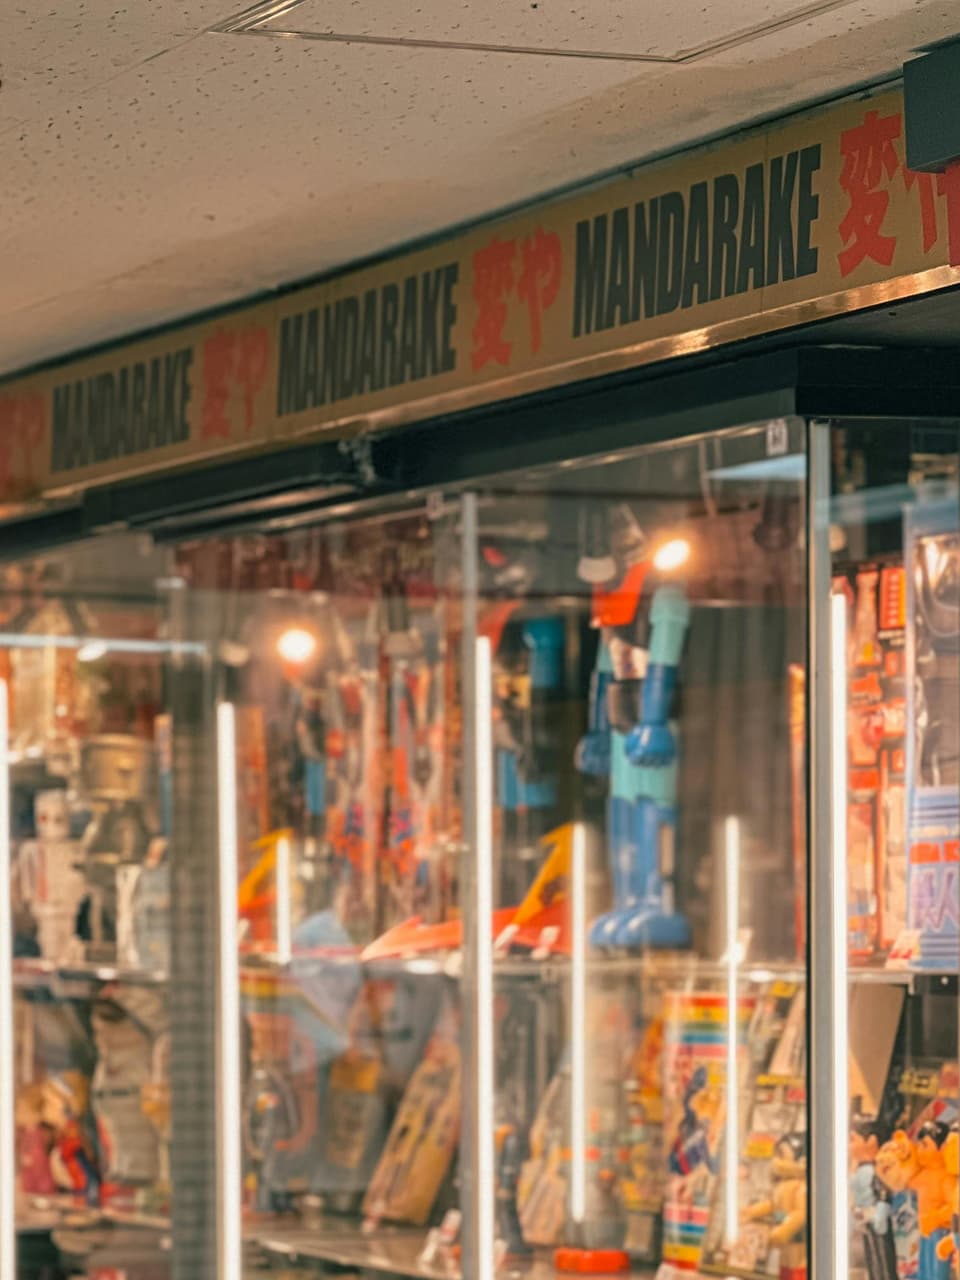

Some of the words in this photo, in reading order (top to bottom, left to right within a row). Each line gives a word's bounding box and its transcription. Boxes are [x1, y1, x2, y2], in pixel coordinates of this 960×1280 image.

[52, 345, 195, 474] MANDARAKE
[201, 325, 269, 440] 変や
[277, 261, 459, 417] MANDARAKE
[471, 224, 562, 372] 変や
[573, 143, 821, 338] MANDARAKE
